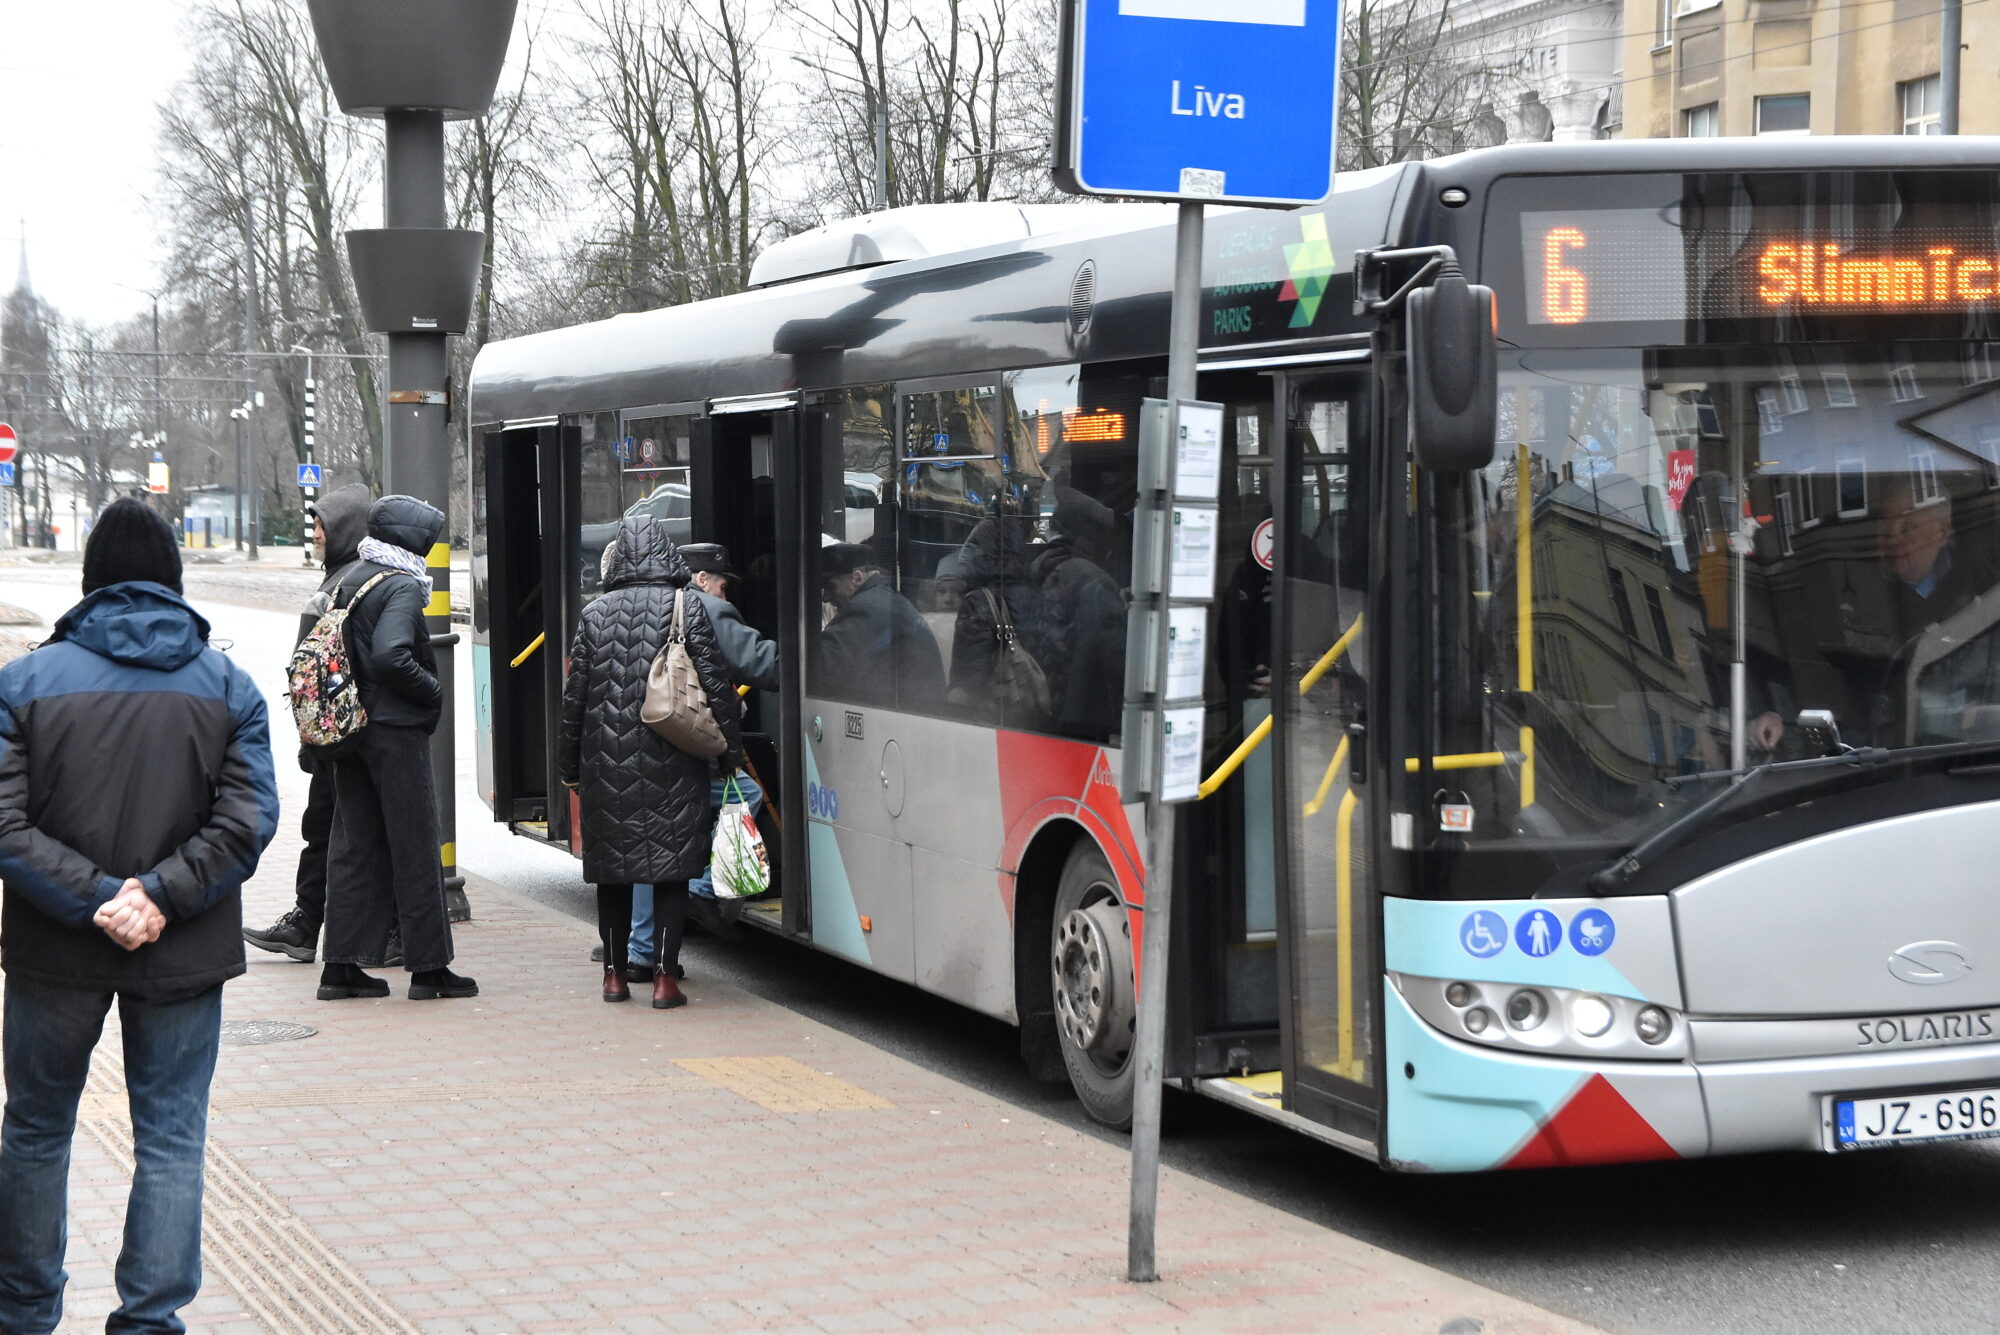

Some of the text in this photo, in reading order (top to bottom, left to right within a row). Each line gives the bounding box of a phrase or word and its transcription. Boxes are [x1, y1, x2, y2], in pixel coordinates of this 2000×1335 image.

[1170, 80, 1245, 119] Līva
[1542, 227, 2000, 324] 6 Slimnīc
[1214, 305, 1252, 335] PARKS
[1857, 1013, 1992, 1046] SOLARIS
[1839, 1125, 1854, 1137] LV
[1865, 1095, 1996, 1137] JZ-696
